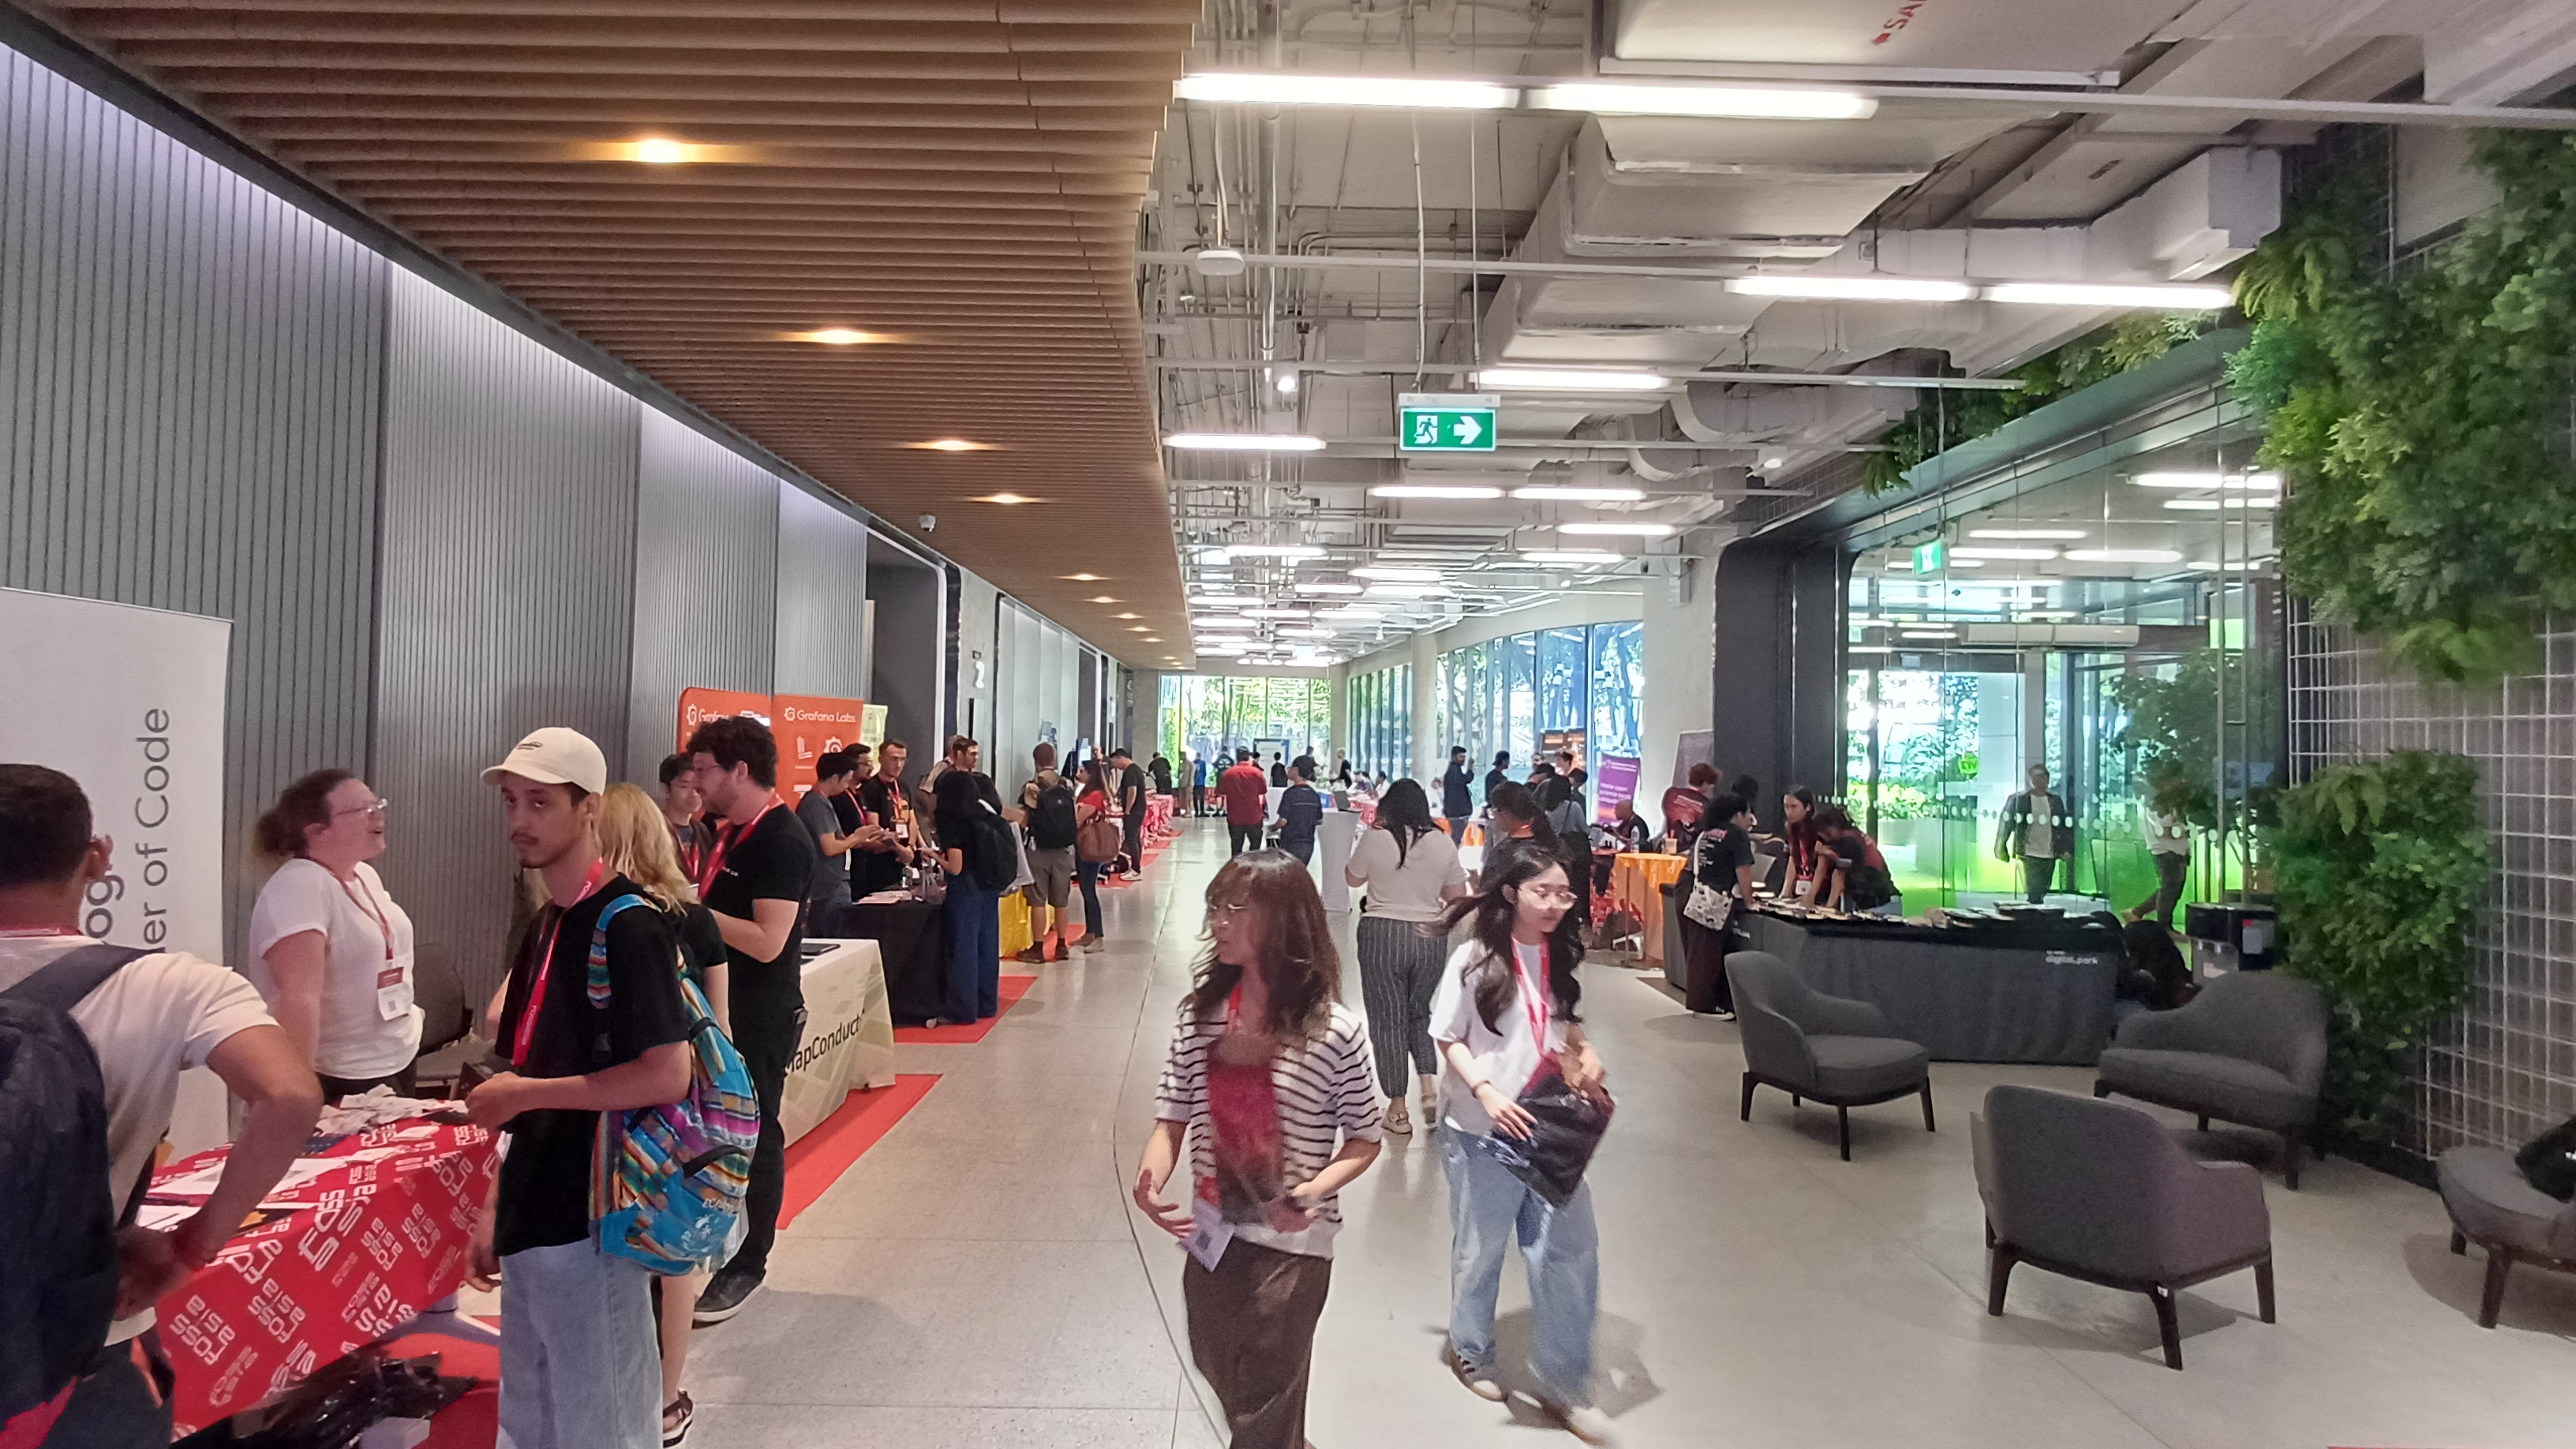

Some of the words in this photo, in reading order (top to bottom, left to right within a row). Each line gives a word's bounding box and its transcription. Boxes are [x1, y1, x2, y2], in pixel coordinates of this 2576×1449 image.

[1883, 0, 1926, 29] SA
[797, 710, 835, 722] Grafana
[836, 712, 856, 723] Labs
[135, 709, 170, 829] Code
[135, 842, 168, 887] of
[85, 874, 125, 939] og
[143, 902, 167, 953] er
[791, 1007, 866, 1073] apConduct
[169, 1313, 219, 1366] foss
[247, 1295, 291, 1344] foss
